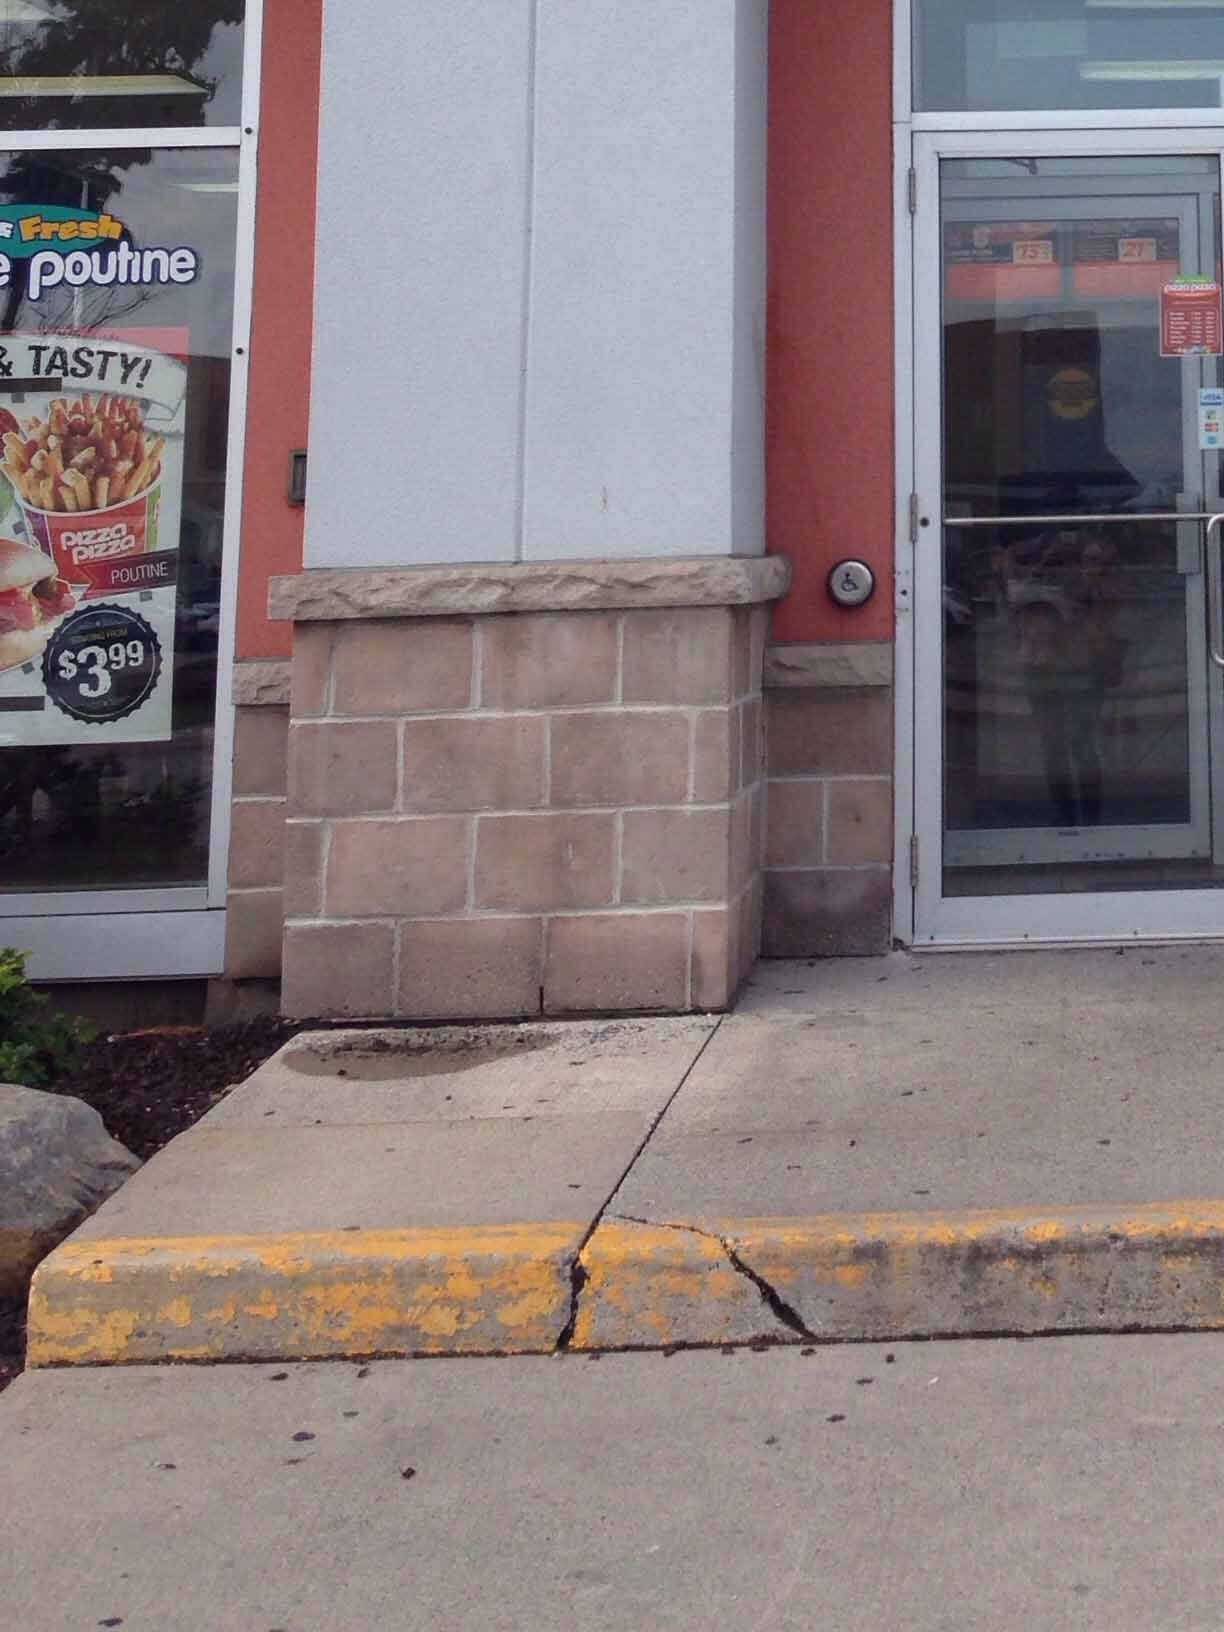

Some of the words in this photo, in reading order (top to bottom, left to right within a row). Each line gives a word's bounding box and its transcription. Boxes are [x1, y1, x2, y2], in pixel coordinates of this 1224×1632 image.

[18, 214, 124, 243] Fresh
[28, 239, 198, 302] poutine
[27, 344, 153, 389] TASTY!
[110, 561, 169, 585] POUTINE
